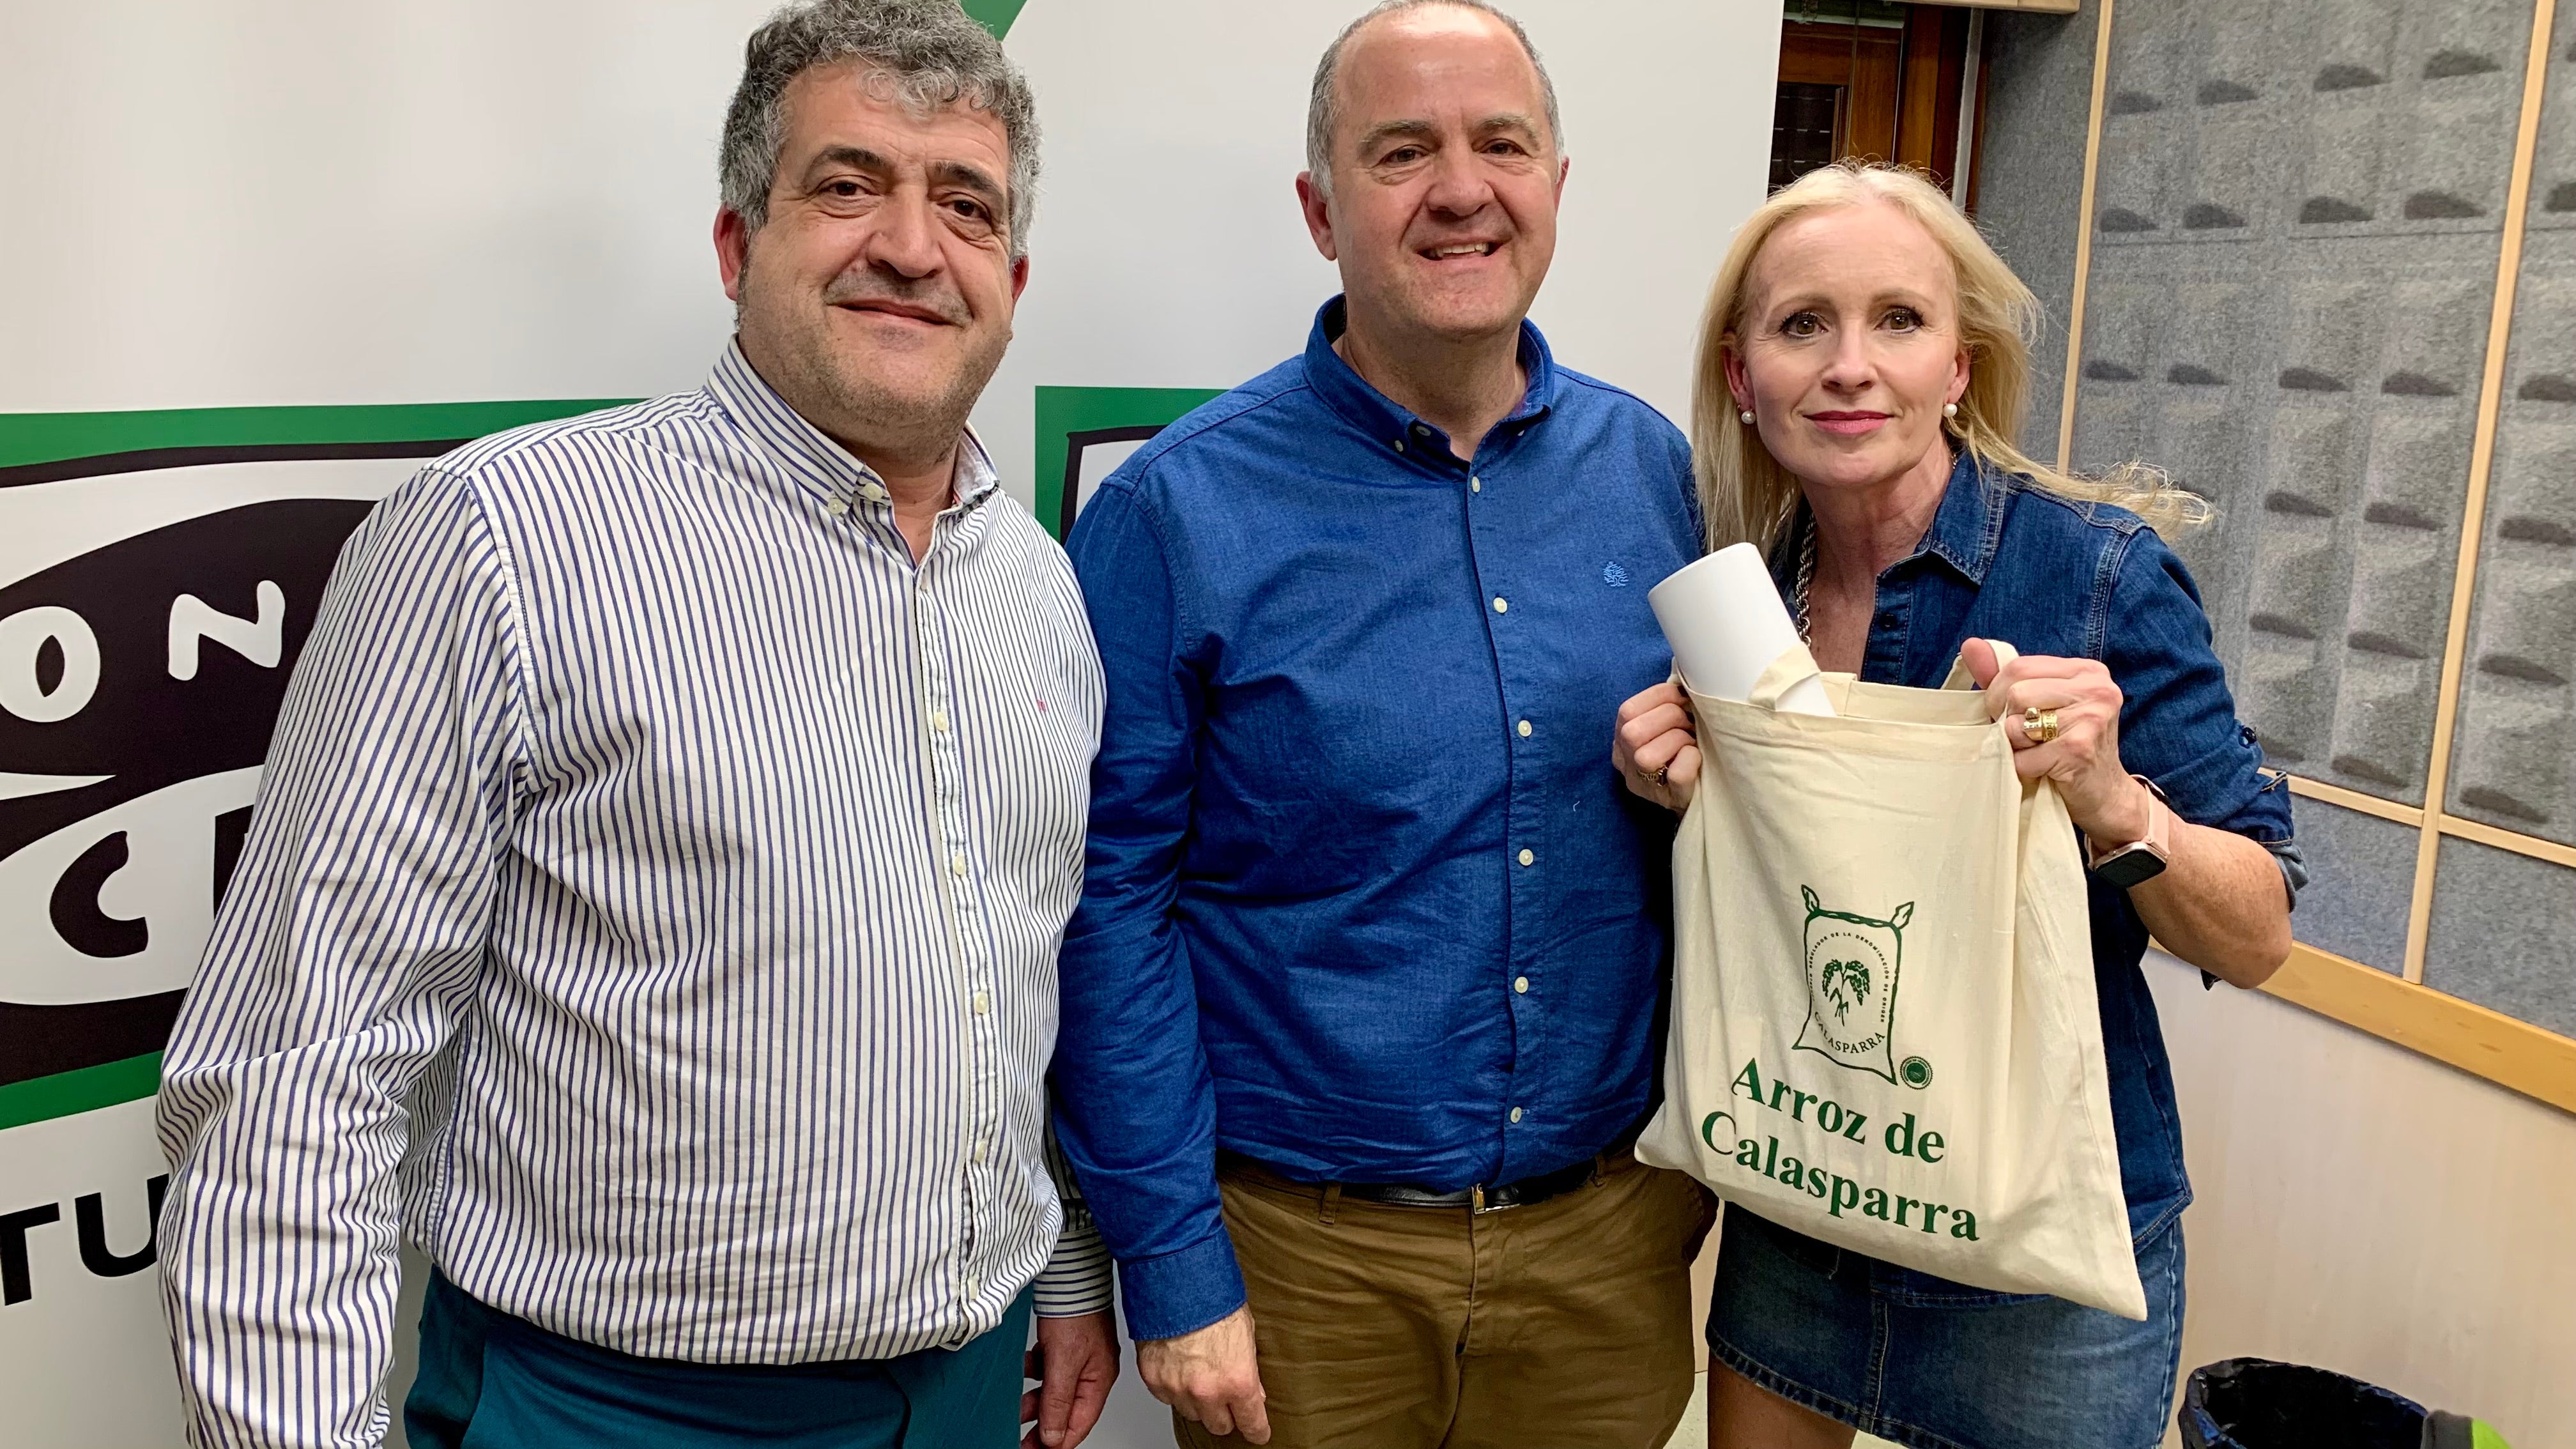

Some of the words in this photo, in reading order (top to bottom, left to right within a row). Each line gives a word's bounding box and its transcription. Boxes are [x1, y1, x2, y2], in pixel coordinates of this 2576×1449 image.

[1814, 1011, 1886, 1054] CALASPARRA
[1730, 1057, 1867, 1146] Arroz
[1885, 1112, 1945, 1163] de
[1701, 1111, 1980, 1242] Calasparra
